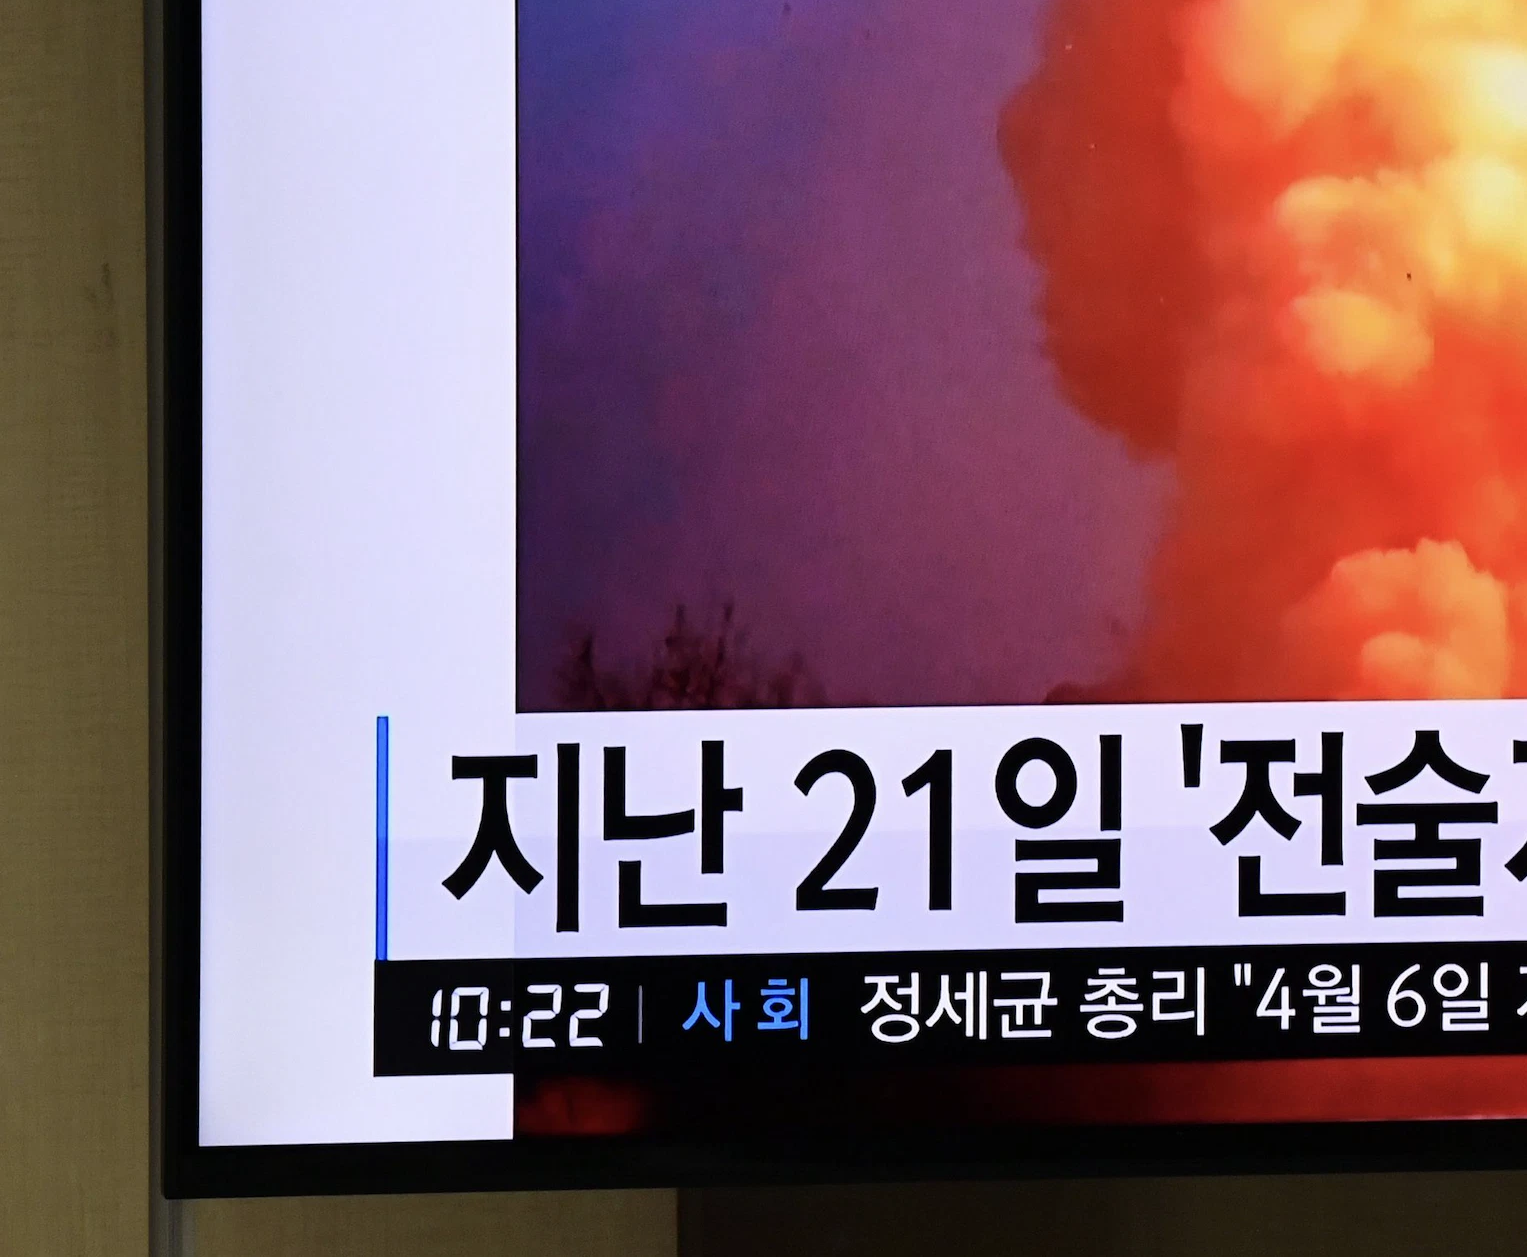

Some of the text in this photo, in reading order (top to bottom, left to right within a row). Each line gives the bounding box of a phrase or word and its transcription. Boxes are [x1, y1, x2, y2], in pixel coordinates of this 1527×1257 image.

[441, 740, 743, 933] 지난
[793, 734, 1124, 924] 21일
[430, 983, 610, 1051] 10:22
[860, 970, 1058, 1043] 정세균
[1079, 966, 1205, 1039] 총리
[1233, 963, 1361, 1034] "4월
[1387, 962, 1490, 1032] 6일
